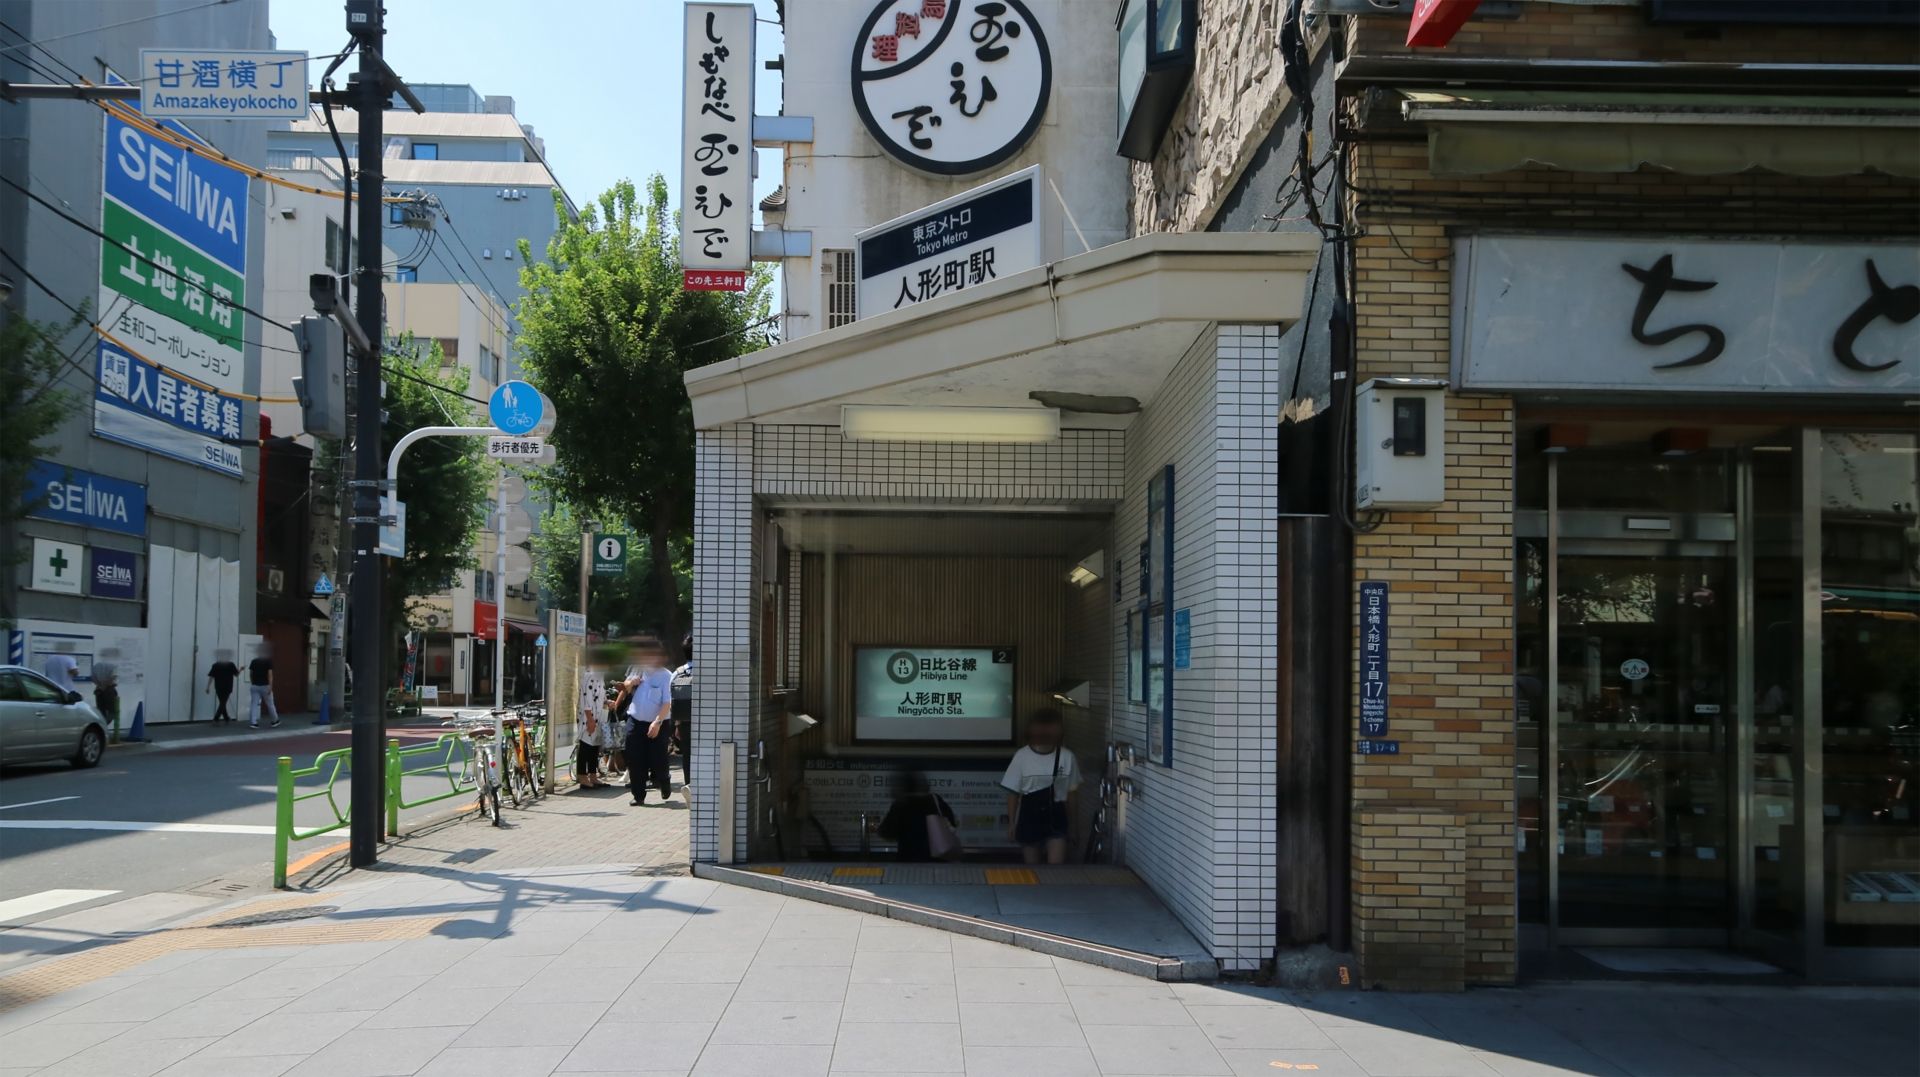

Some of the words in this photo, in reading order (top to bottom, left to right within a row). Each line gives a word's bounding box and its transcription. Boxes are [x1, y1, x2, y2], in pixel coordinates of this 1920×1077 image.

[154, 59, 293, 90] 甘酒横丁
[153, 93, 298, 112] Amazakeyokocho
[118, 126, 239, 245] SEIWA
[912, 207, 971, 244] 東京メトロ
[917, 239, 941, 256] Tokyo
[942, 229, 968, 247] Metro
[119, 235, 233, 329] 土地活用
[687, 275, 742, 286] この先三軒目
[893, 247, 997, 309] 人形町駅
[118, 312, 231, 378] 生和コーポレーション
[131, 366, 240, 440] 入居者募集
[491, 442, 540, 454] 歩行者優先
[47, 477, 129, 523] SEIWA
[1364, 588, 1384, 596] 中央区
[1367, 597, 1381, 680] 日本橋人形町一丁目
[920, 658, 977, 671] 日比谷線
[998, 652, 1006, 662] 2
[897, 667, 909, 675] 13
[920, 672, 948, 682] Hibiya
[950, 672, 968, 681] Line
[1364, 682, 1384, 697] 17
[900, 692, 962, 706] 人形町駅
[898, 706, 944, 716] Ningyōchō
[946, 706, 965, 715] Sta.
[1369, 723, 1380, 732] 17
